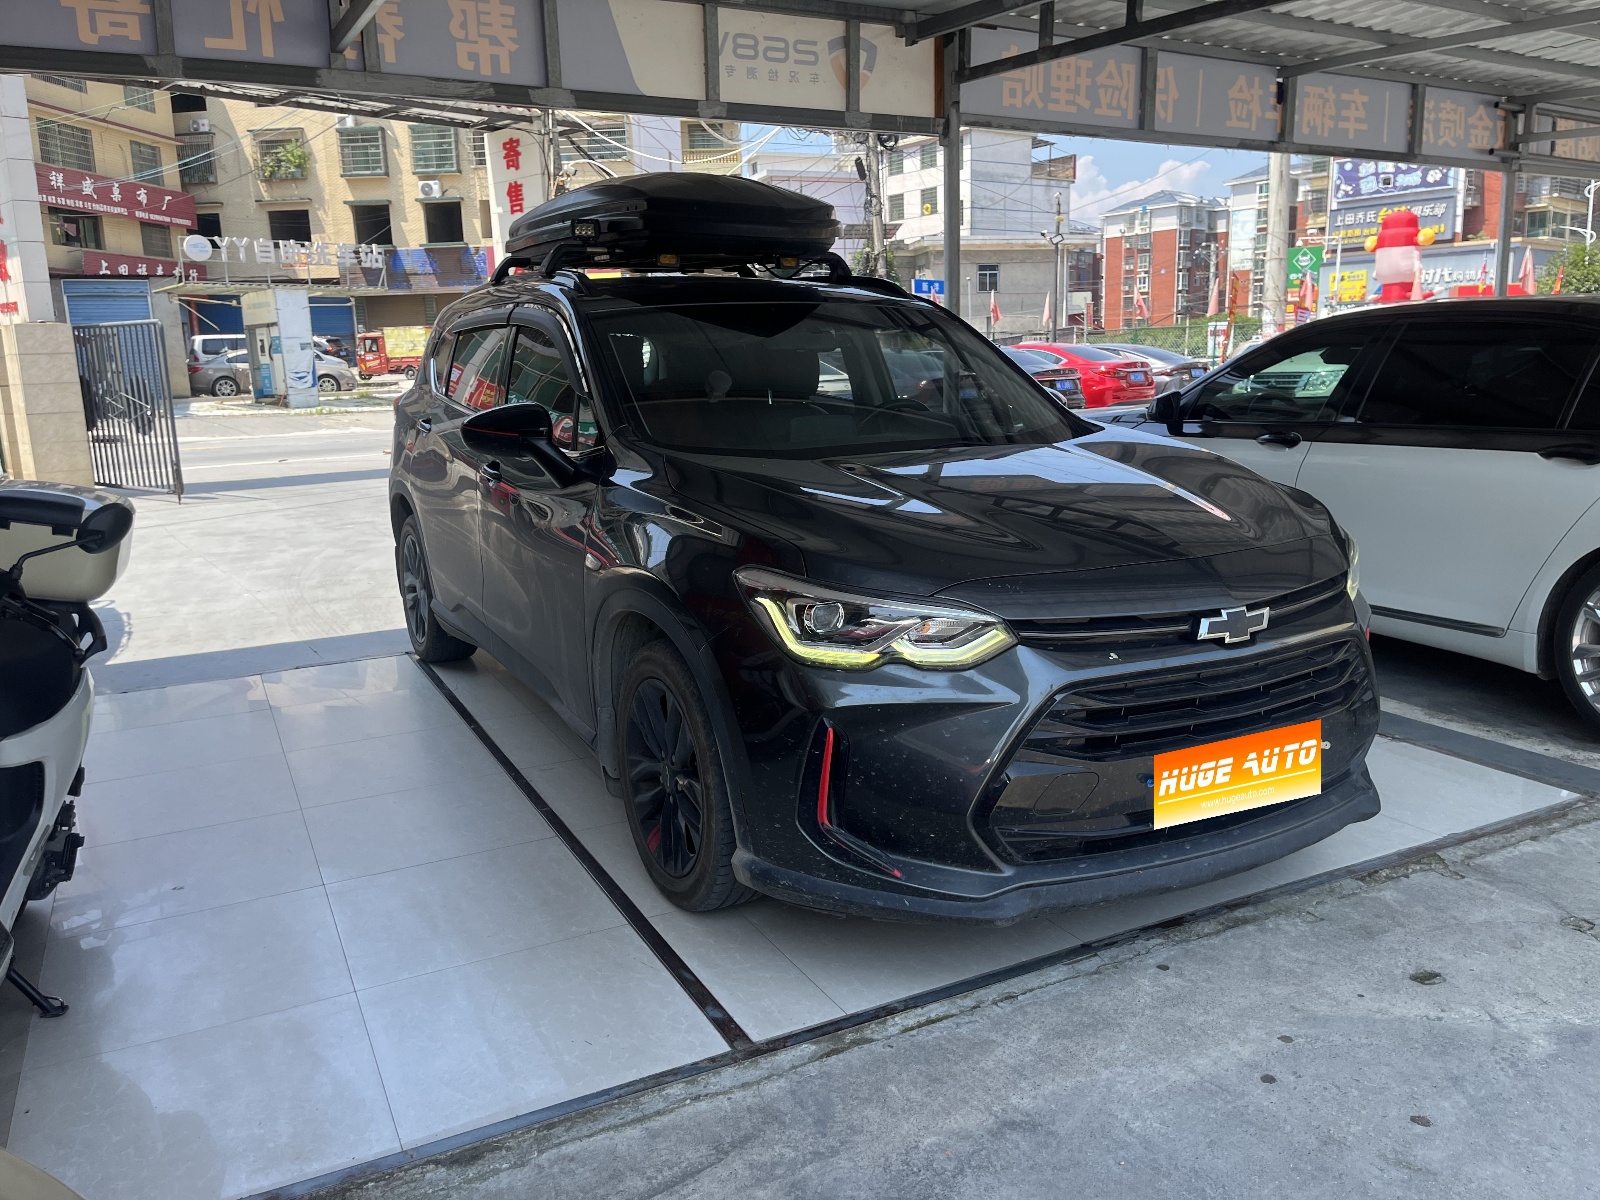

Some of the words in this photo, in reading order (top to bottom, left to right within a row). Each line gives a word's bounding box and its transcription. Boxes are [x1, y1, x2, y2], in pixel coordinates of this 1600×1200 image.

[49, 170, 173, 211] 祥盛桌布厂
[502, 137, 525, 215] 寄售
[1334, 202, 1447, 227] 上田乔氏台俱乐部
[213, 235, 385, 269] YY自助洗车站
